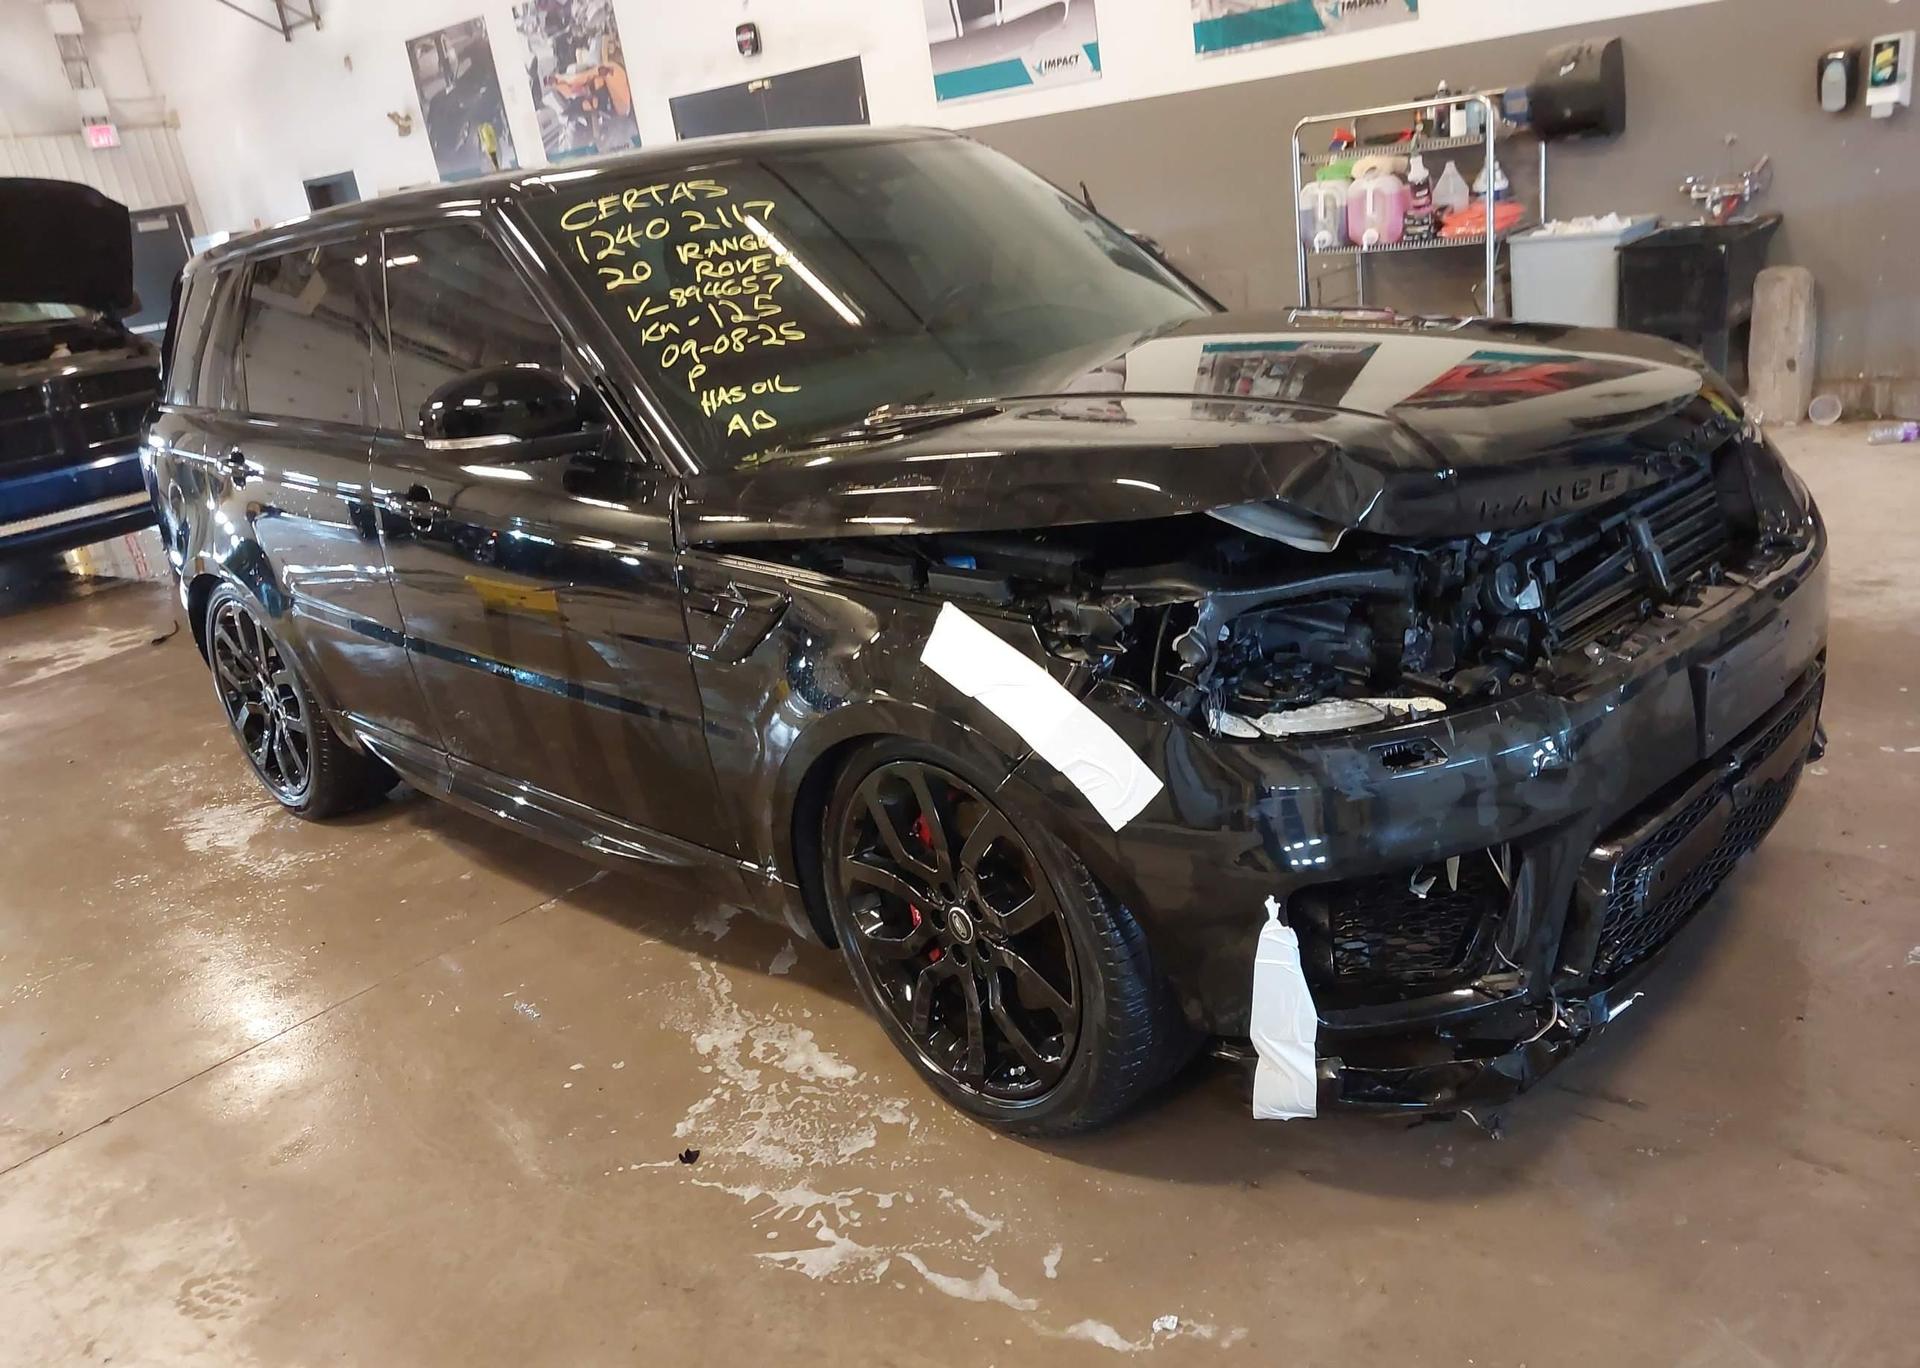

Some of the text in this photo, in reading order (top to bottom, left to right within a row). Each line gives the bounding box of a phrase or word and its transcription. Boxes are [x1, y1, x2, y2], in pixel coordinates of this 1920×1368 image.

[1043, 54, 1080, 71] IMPACT
[560, 179, 729, 232] CERTAS
[575, 200, 776, 265] 1240 2117
[598, 260, 653, 291] 20
[660, 320, 807, 369] 09-08-25
[687, 362, 707, 393] P
[700, 373, 802, 419] HAS OIL
